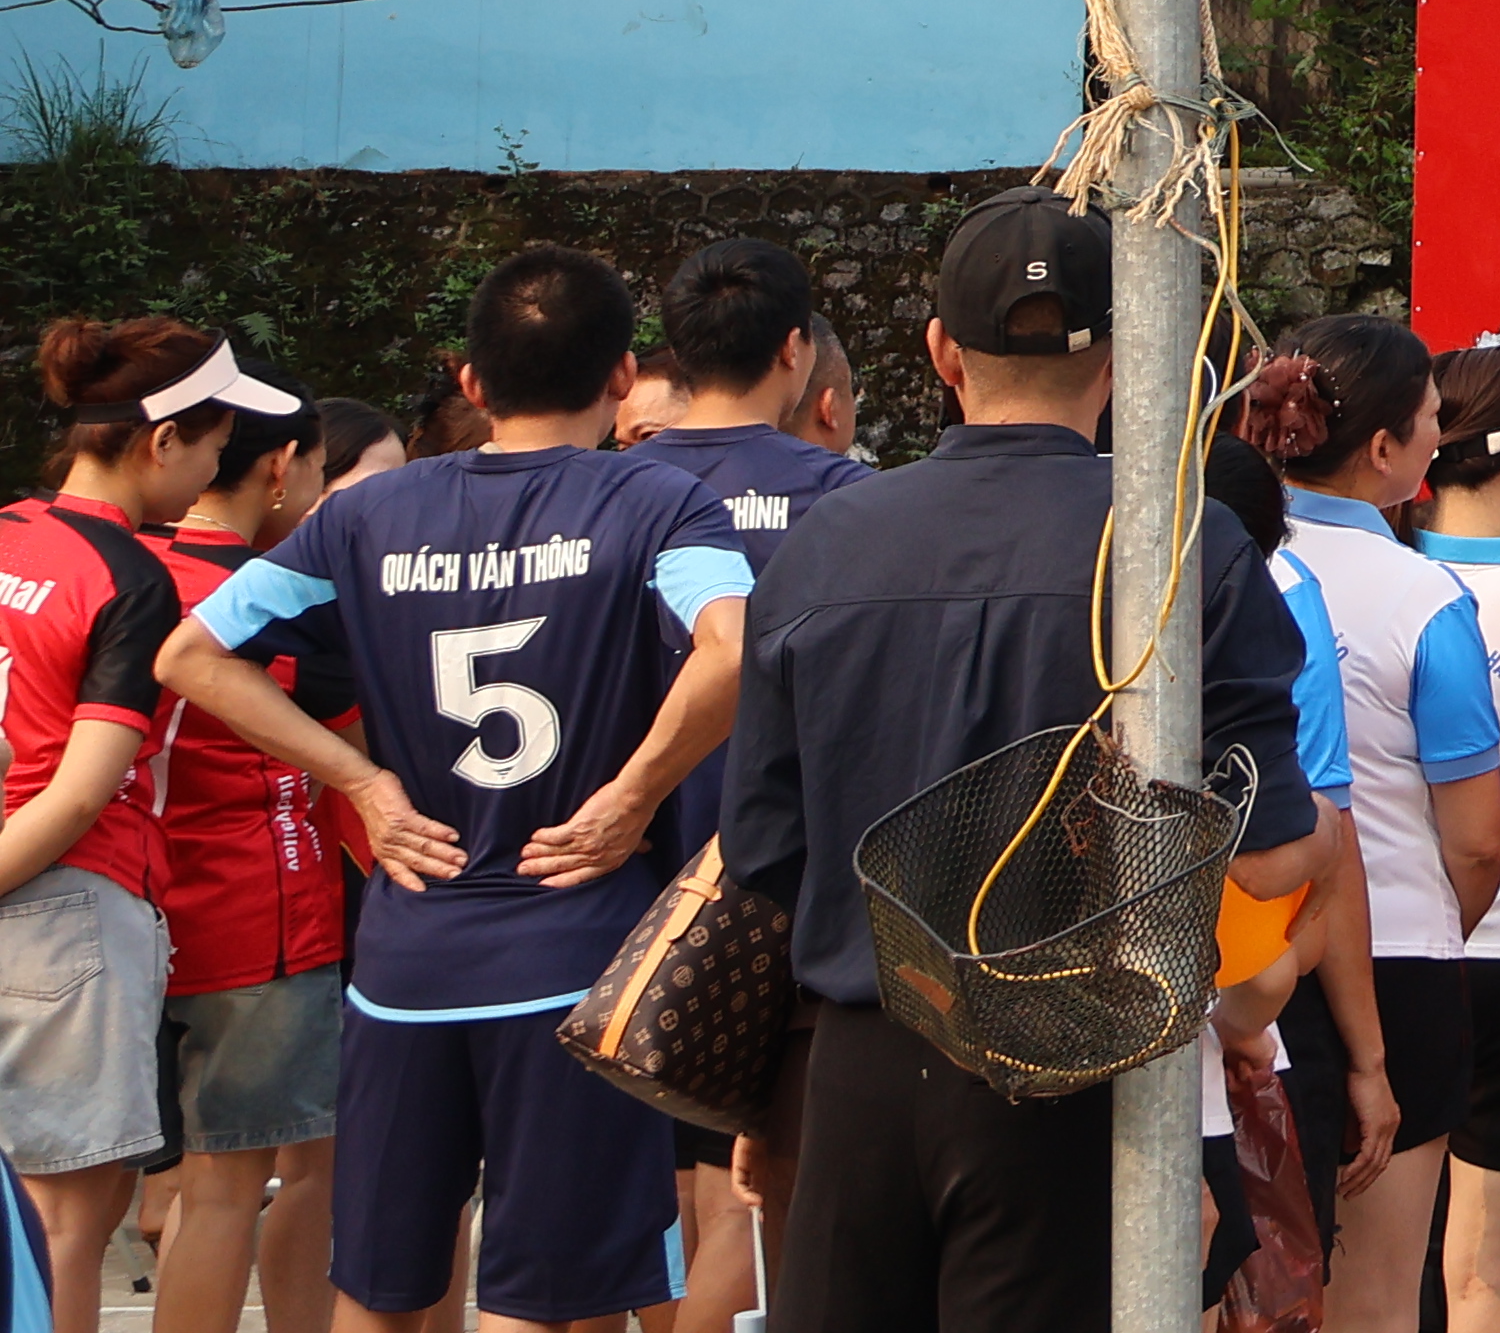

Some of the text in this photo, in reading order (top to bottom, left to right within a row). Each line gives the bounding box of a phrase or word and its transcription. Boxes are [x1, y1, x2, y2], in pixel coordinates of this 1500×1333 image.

[1026, 261, 1048, 281] S
[722, 488, 789, 530] HÌNH
[382, 533, 592, 597] QUÁCH VĂN THÔNG
[432, 616, 561, 789] 5
